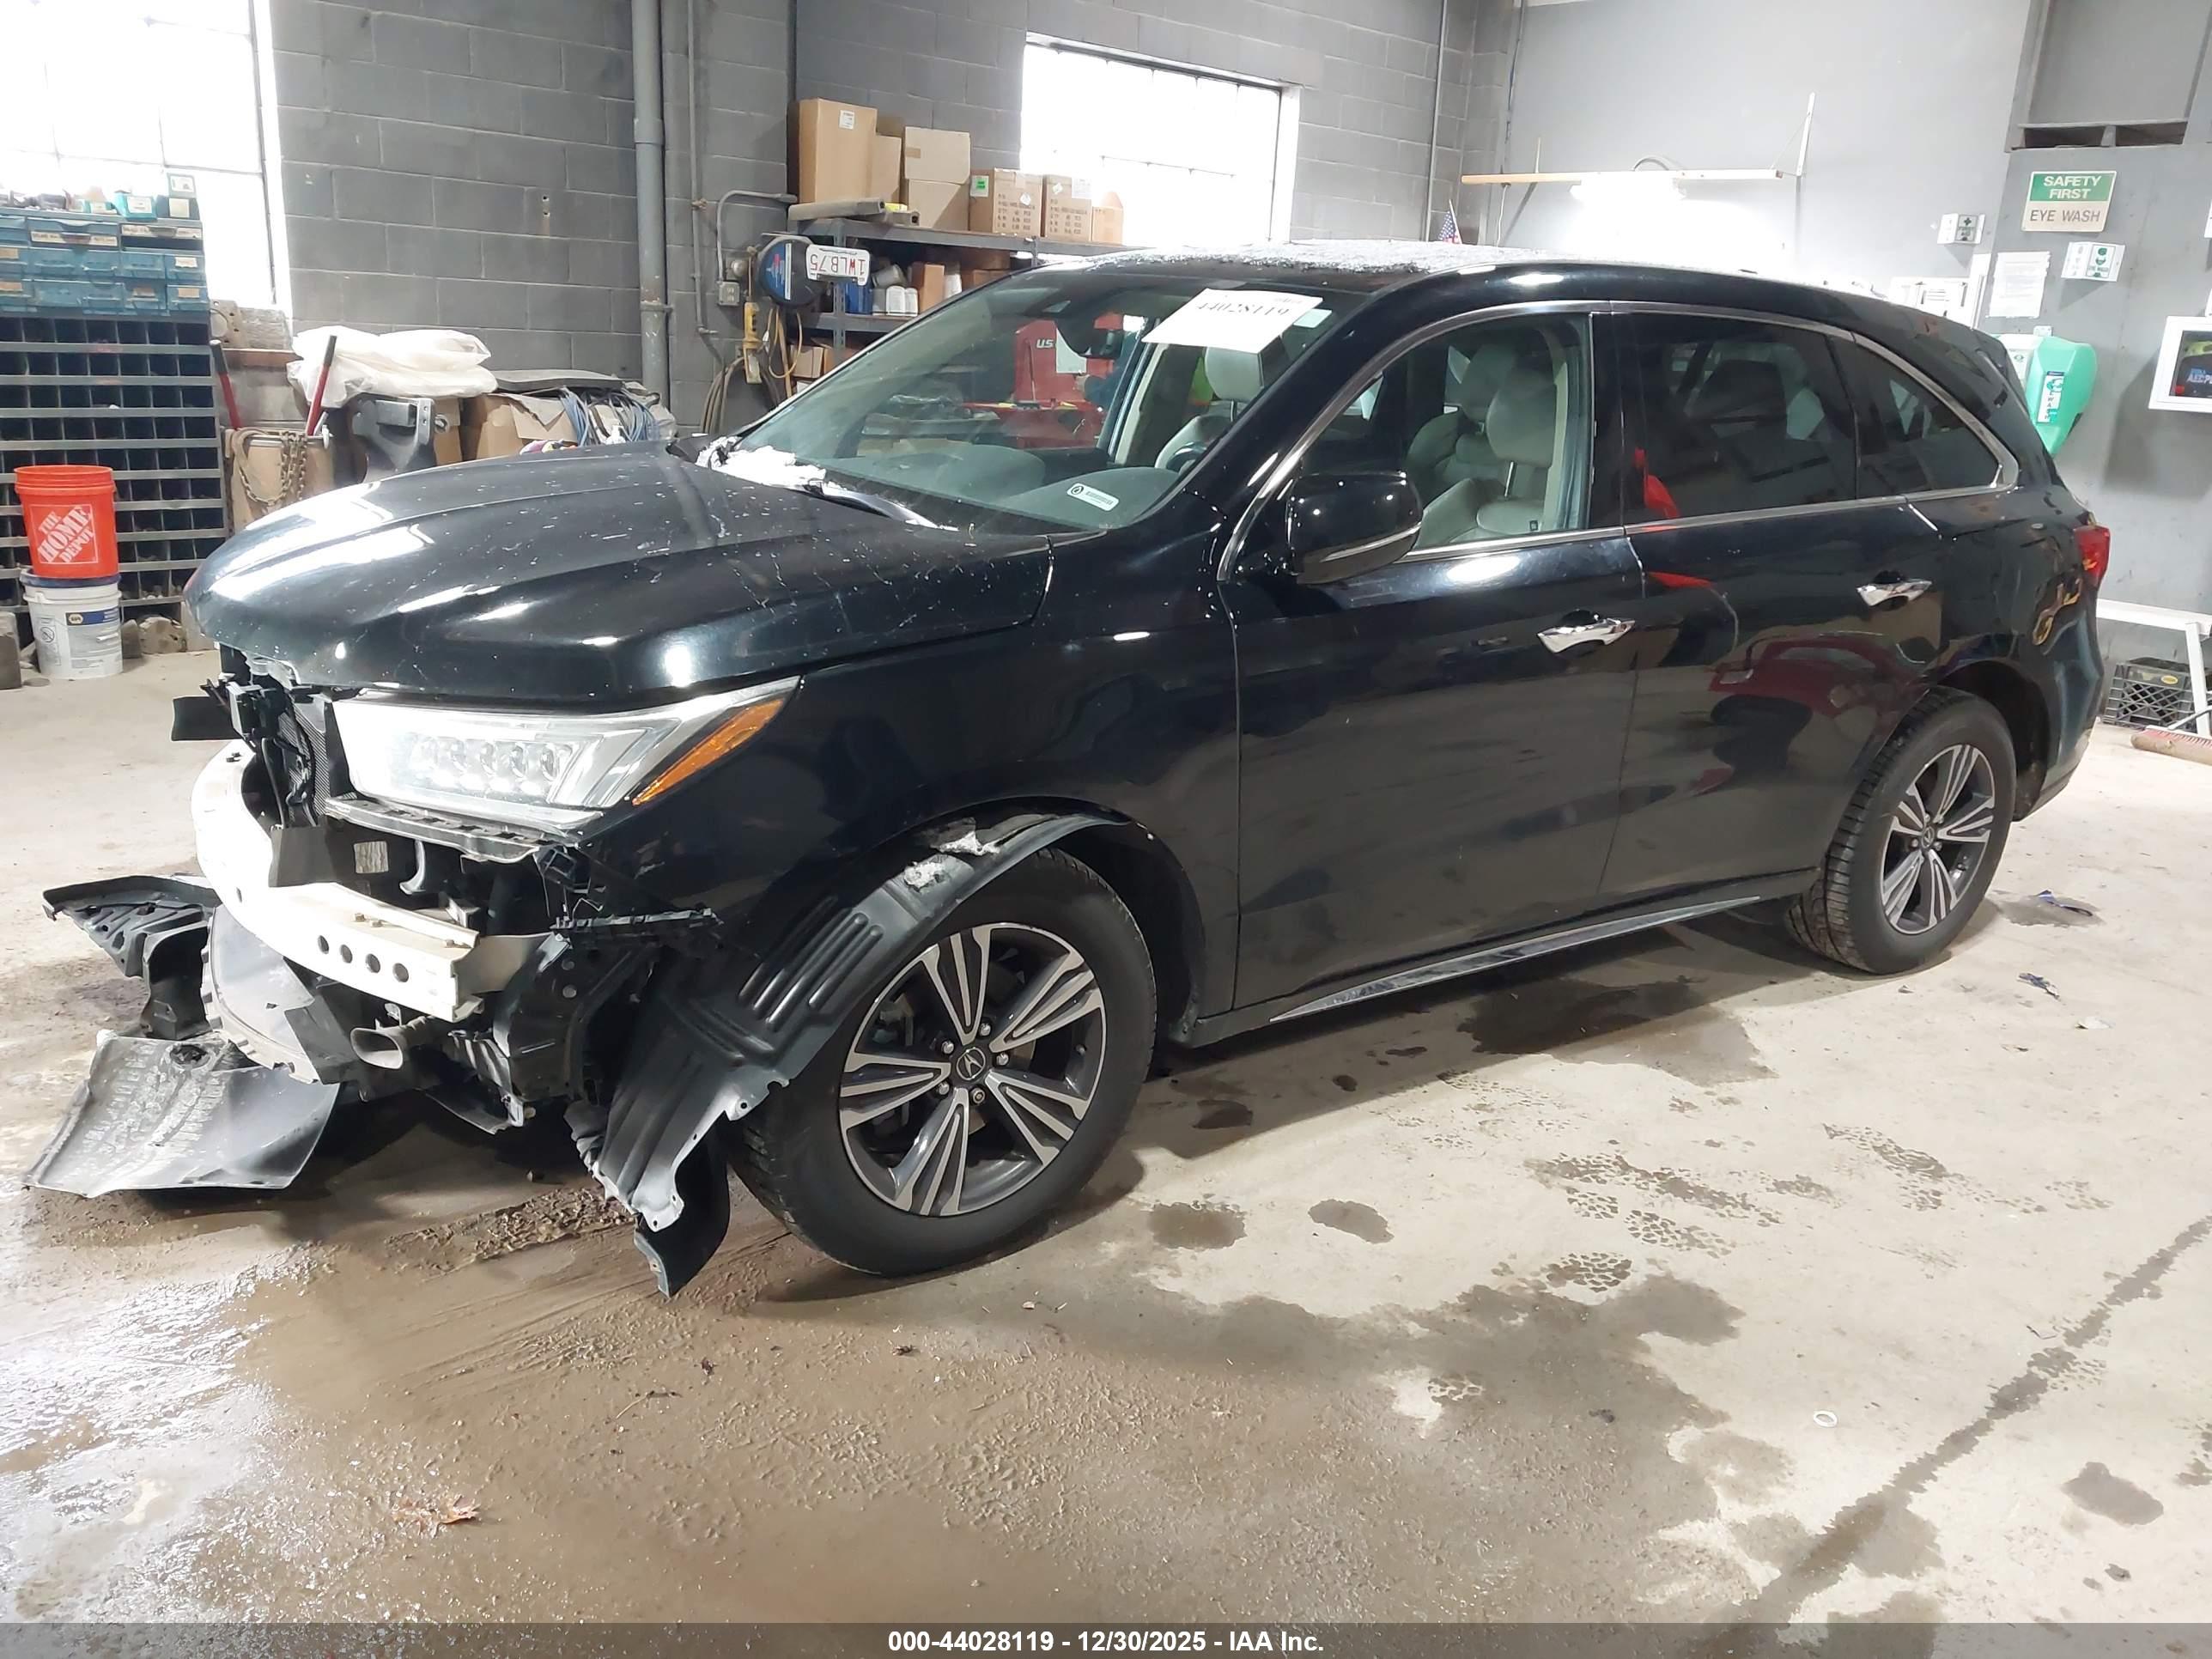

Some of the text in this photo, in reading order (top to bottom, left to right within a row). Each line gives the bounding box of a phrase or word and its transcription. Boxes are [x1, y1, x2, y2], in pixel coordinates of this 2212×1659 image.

[2044, 175, 2102, 187] SAFETY
[2049, 188, 2092, 199] FIRST
[2030, 210, 2100, 222] EYE WASH
[38, 511, 62, 534] THE
[37, 506, 92, 563] HOME
[59, 526, 94, 563] DEPOT
